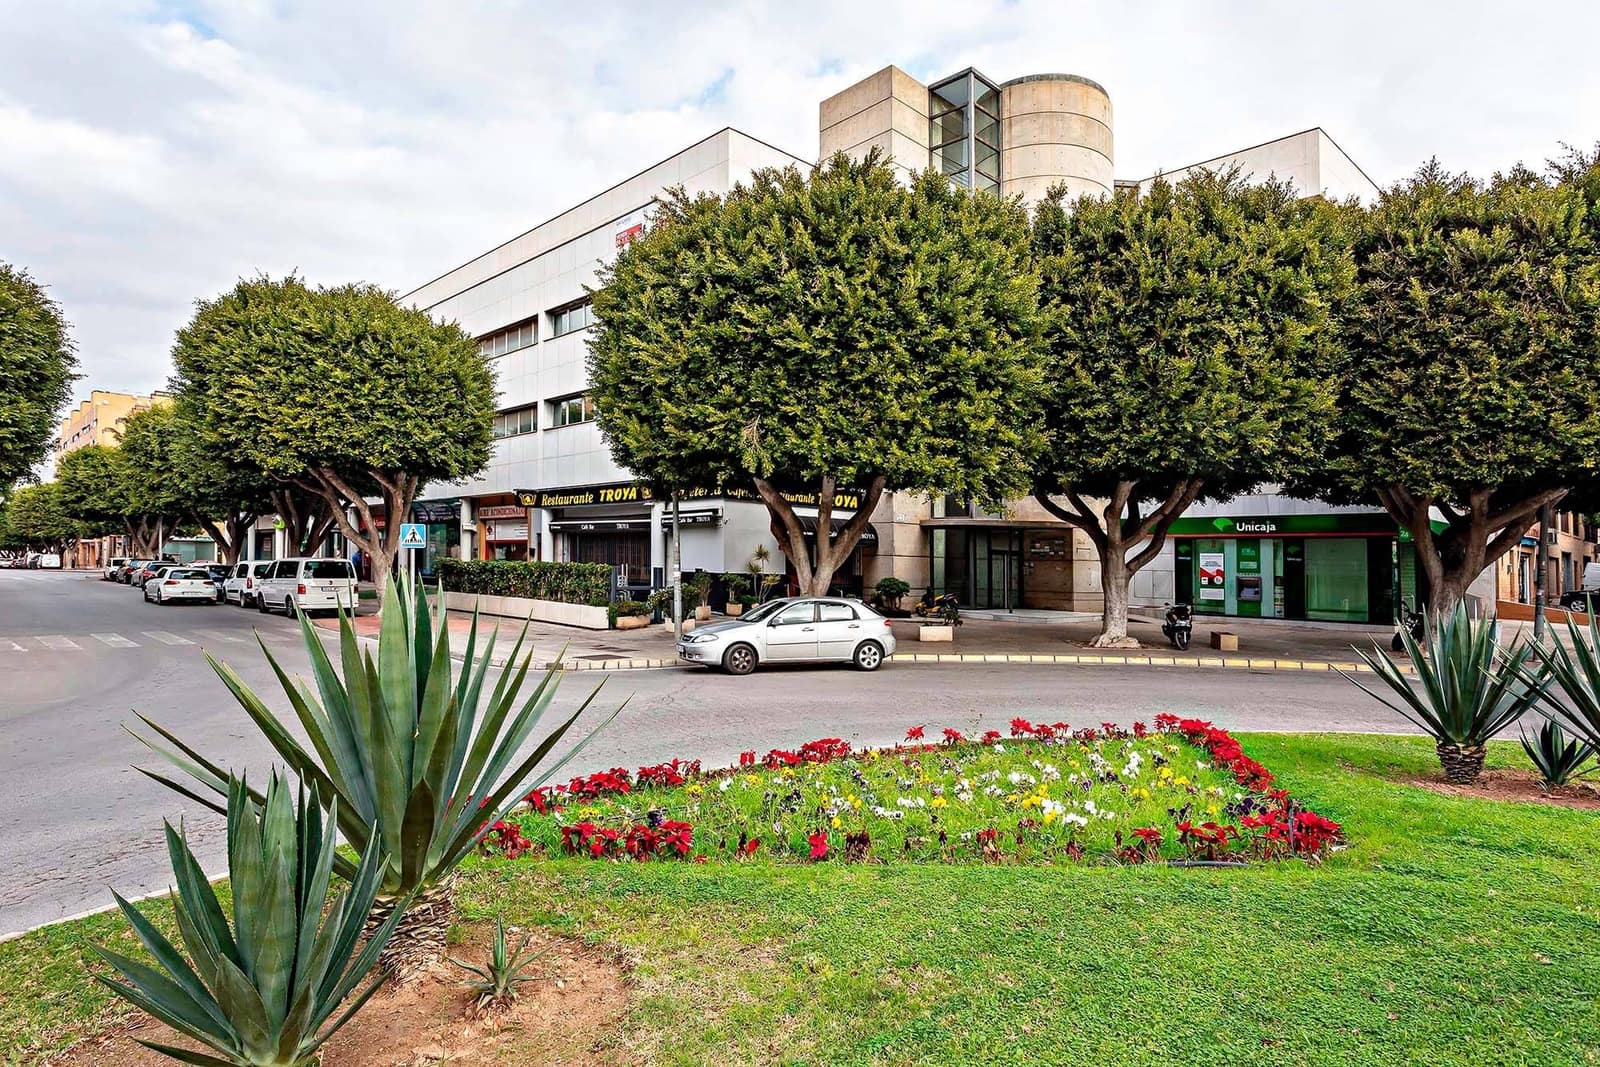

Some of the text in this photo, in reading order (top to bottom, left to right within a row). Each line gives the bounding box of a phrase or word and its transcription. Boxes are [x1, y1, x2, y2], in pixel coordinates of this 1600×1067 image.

[541, 487, 637, 506] Restaurante TROYA
[817, 493, 858, 508] TOYA
[1236, 520, 1276, 533] Unicaja
